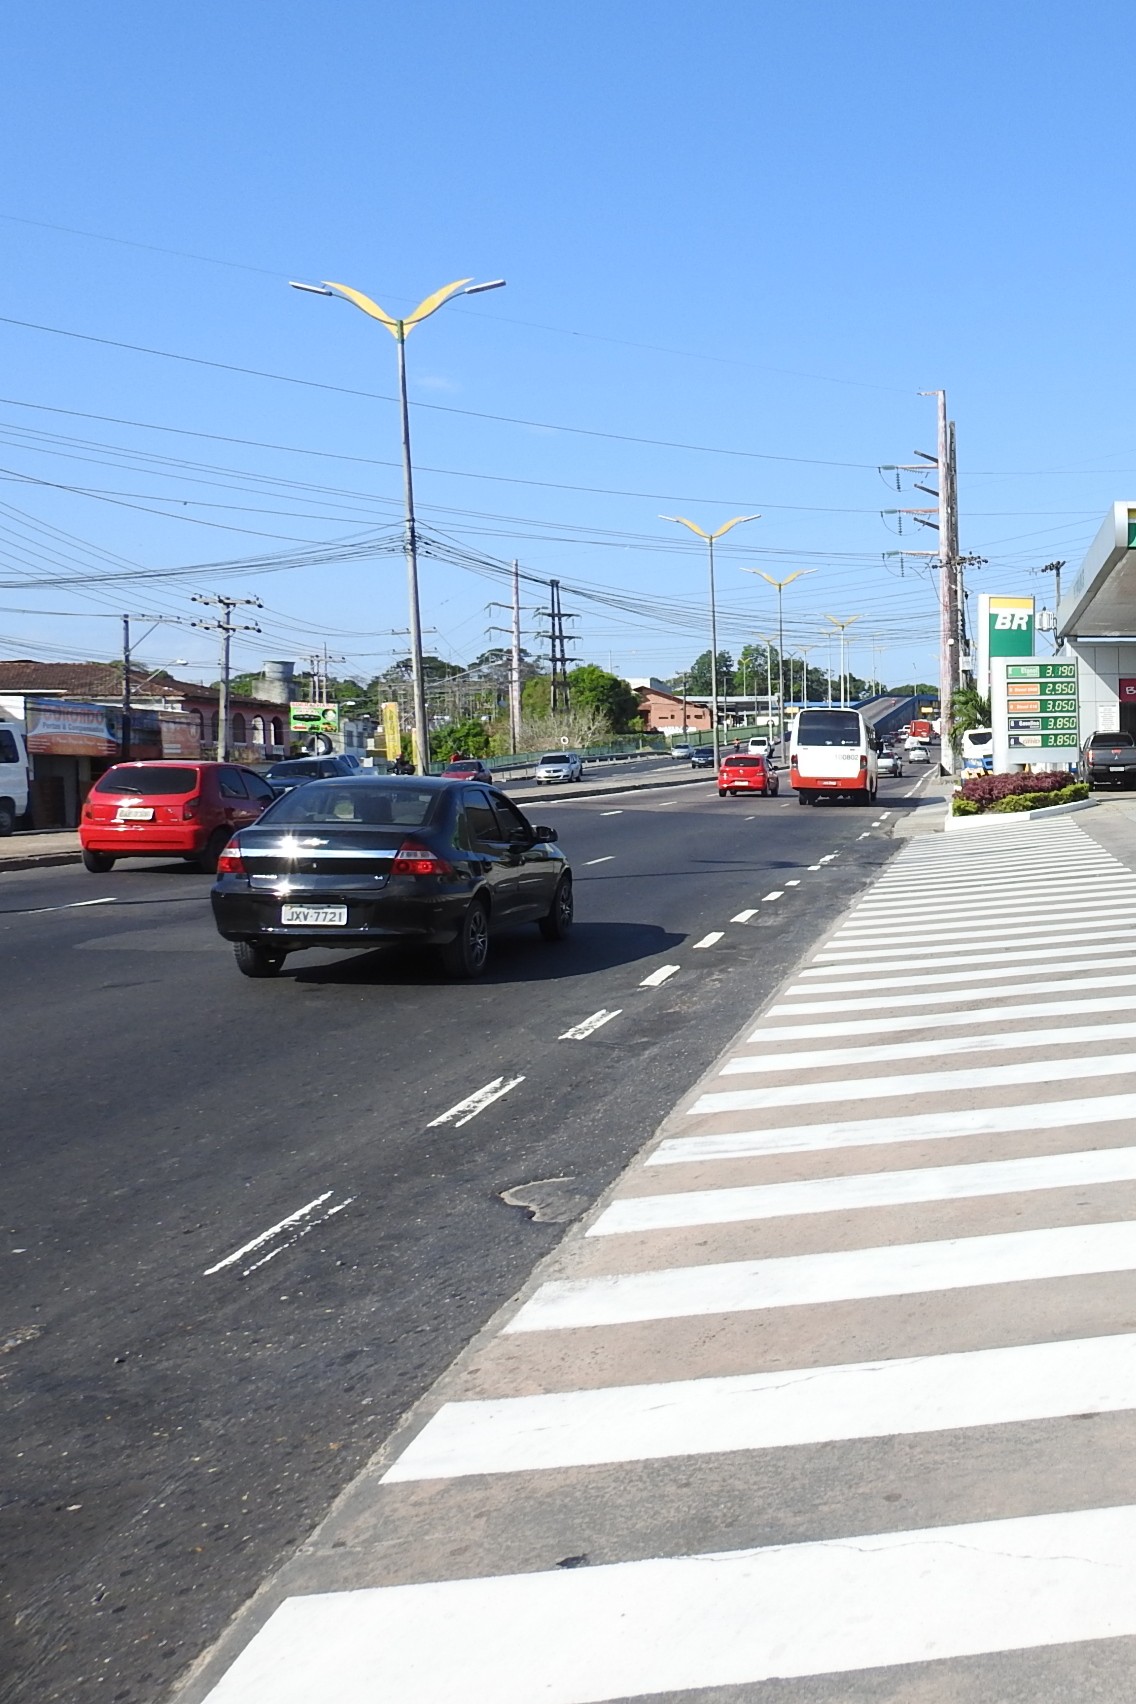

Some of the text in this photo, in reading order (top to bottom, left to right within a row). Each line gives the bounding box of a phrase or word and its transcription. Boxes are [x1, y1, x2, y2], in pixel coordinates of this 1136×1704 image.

[994, 613, 1029, 630] BR
[1045, 683, 1075, 695] 2.950
[1046, 700, 1075, 712] 3.050
[1047, 718, 1077, 729] 3.850
[1047, 734, 1077, 746] 3.850
